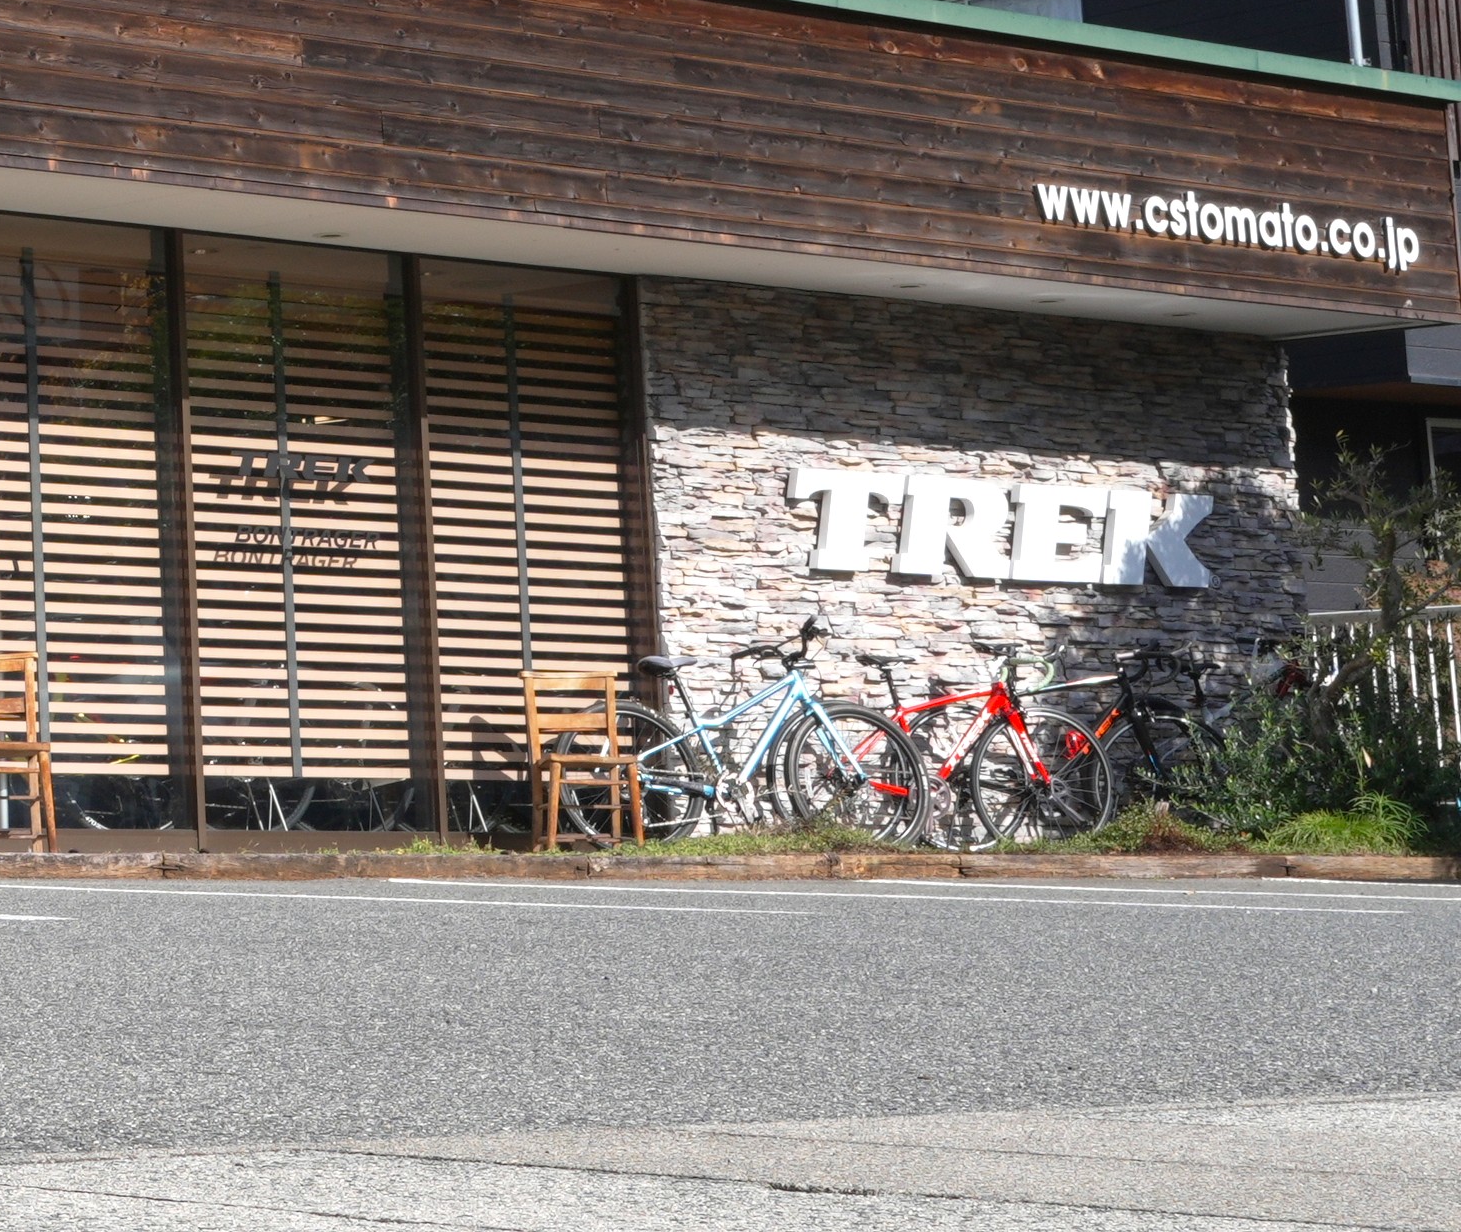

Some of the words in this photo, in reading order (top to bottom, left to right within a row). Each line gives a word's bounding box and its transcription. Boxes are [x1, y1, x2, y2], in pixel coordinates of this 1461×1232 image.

[1035, 183, 1420, 271] www.cstomato.co.jp
[230, 450, 376, 482] TREK
[234, 525, 380, 550] BONTRAGER
[788, 468, 1214, 588] TREK
[945, 707, 992, 771] TREK
